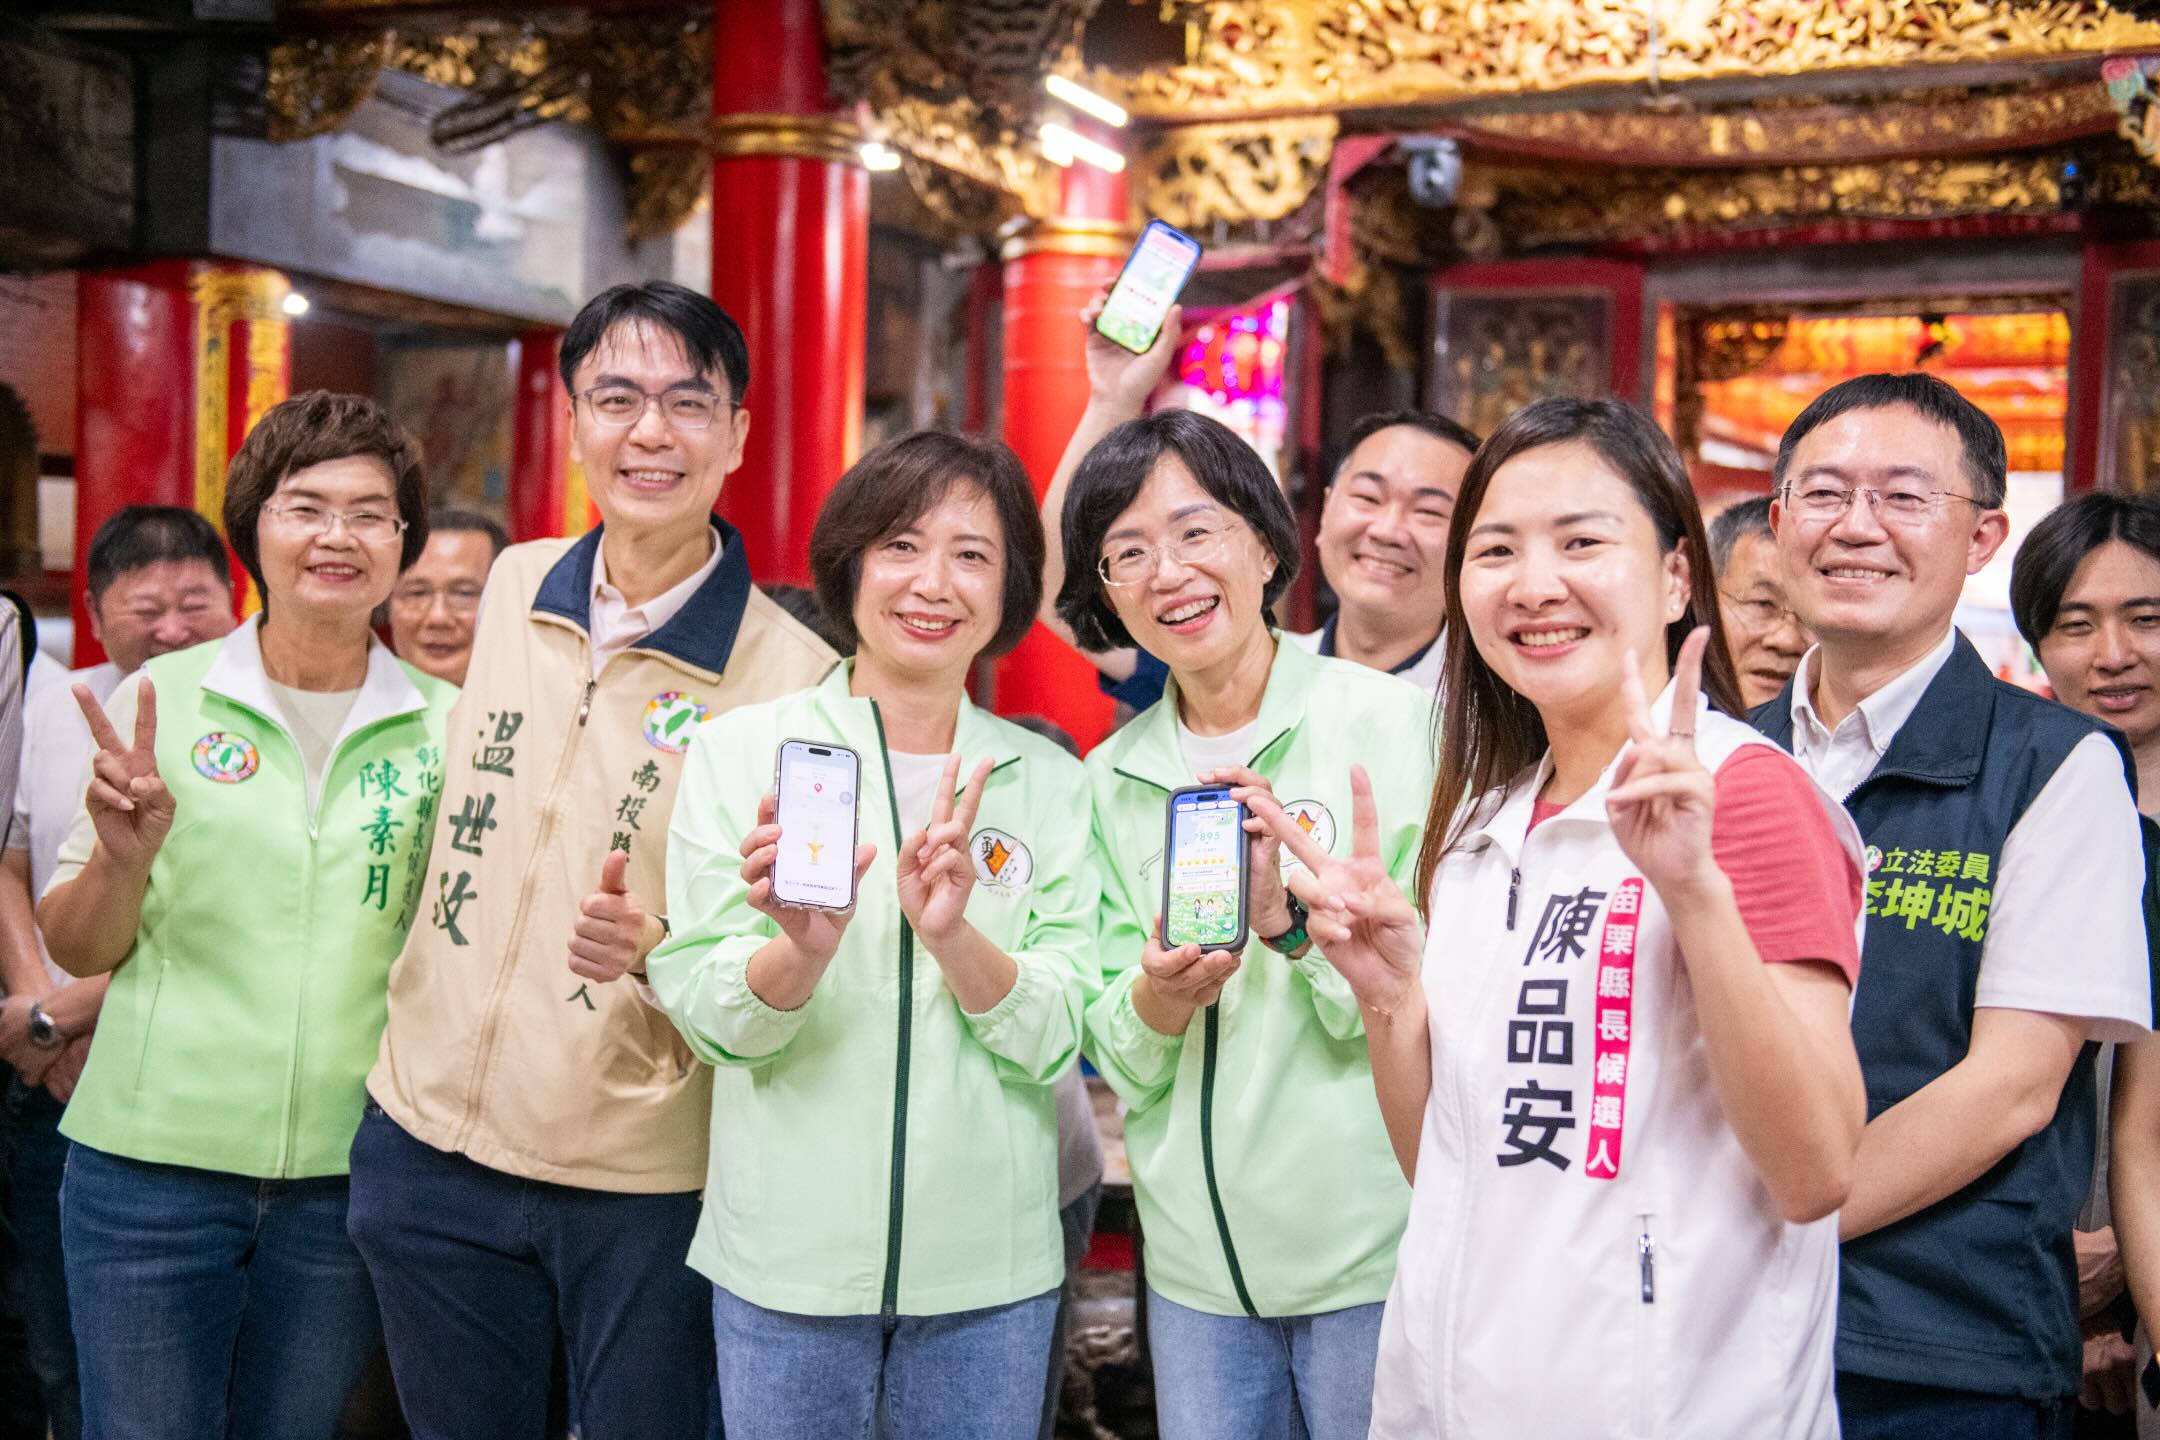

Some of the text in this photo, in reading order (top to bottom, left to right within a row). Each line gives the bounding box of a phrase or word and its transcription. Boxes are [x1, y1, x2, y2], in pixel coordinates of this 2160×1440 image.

[359, 758, 409, 912] 陳素月
[566, 759, 661, 1011] 南投縣人
[1880, 847, 1990, 883] 立法委員
[1496, 886, 1608, 1172] 陳品安
[1586, 883, 1642, 1174] 苗栗縣長候選人
